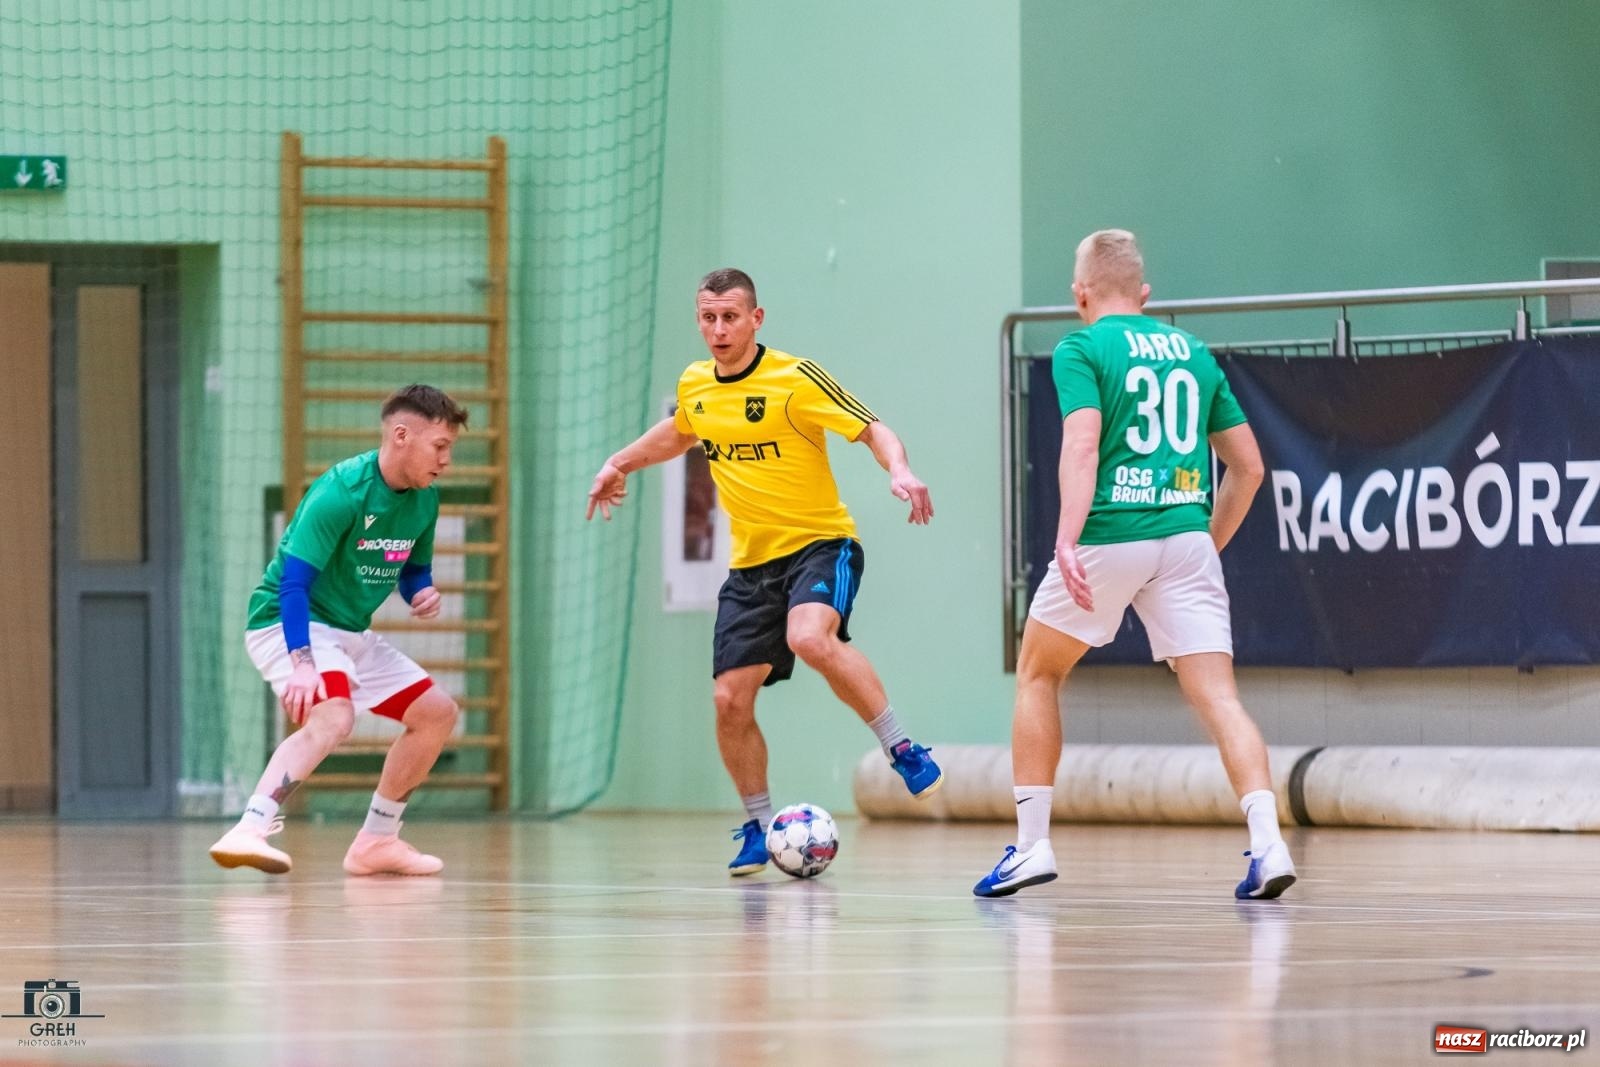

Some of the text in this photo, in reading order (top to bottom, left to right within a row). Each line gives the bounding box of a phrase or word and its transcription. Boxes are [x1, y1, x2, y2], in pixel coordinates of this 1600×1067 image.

[1123, 330, 1191, 361] JARO
[1125, 365, 1200, 455] 30
[1115, 465, 1153, 488] OSG
[1271, 431, 1600, 553] RACIBÓRZ
[1111, 485, 1156, 505] BRUKI
